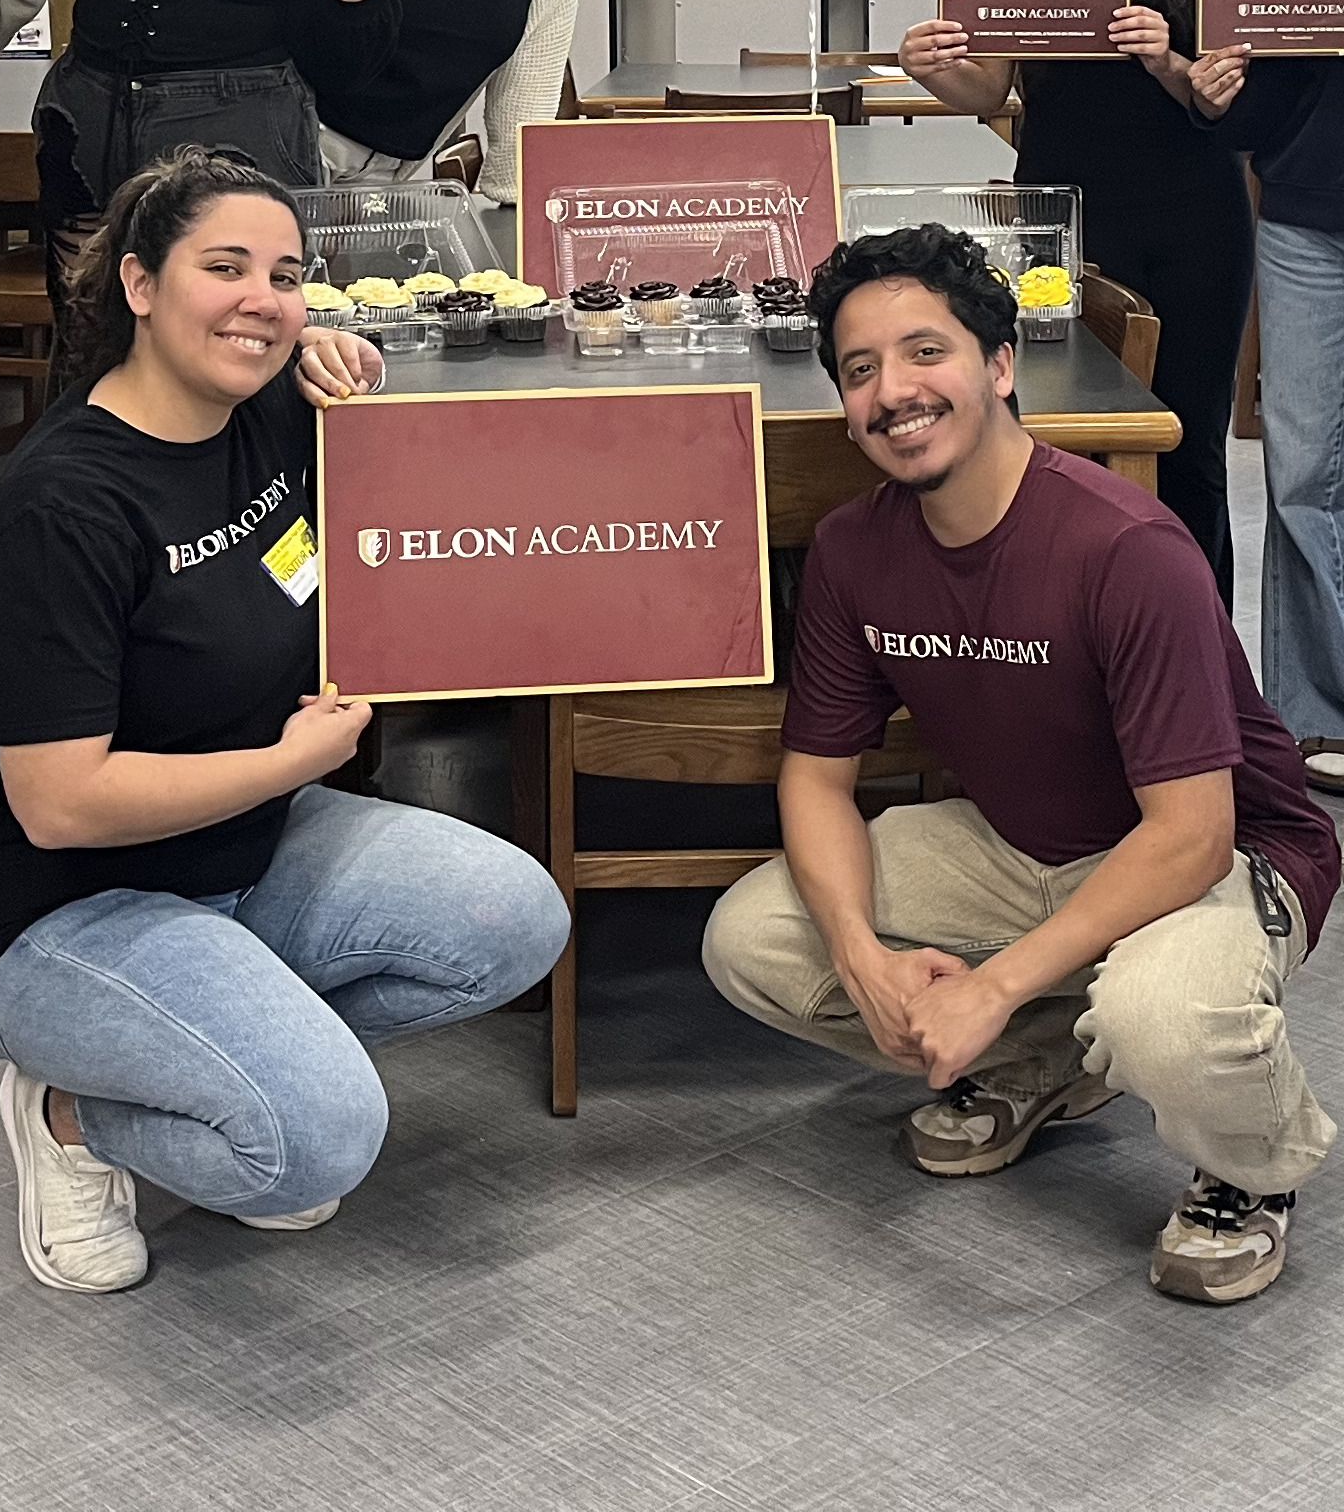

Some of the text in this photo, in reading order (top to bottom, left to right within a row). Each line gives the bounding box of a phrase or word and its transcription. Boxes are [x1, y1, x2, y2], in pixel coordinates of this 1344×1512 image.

[991, 8, 1090, 19] ELON ACADEMY
[1252, 4, 1289, 15] ELON
[575, 196, 809, 219] ELON ACADEMY
[398, 520, 723, 561] ELON ACADEMY
[279, 550, 309, 582] VISITOR
[882, 632, 952, 658] ELON
